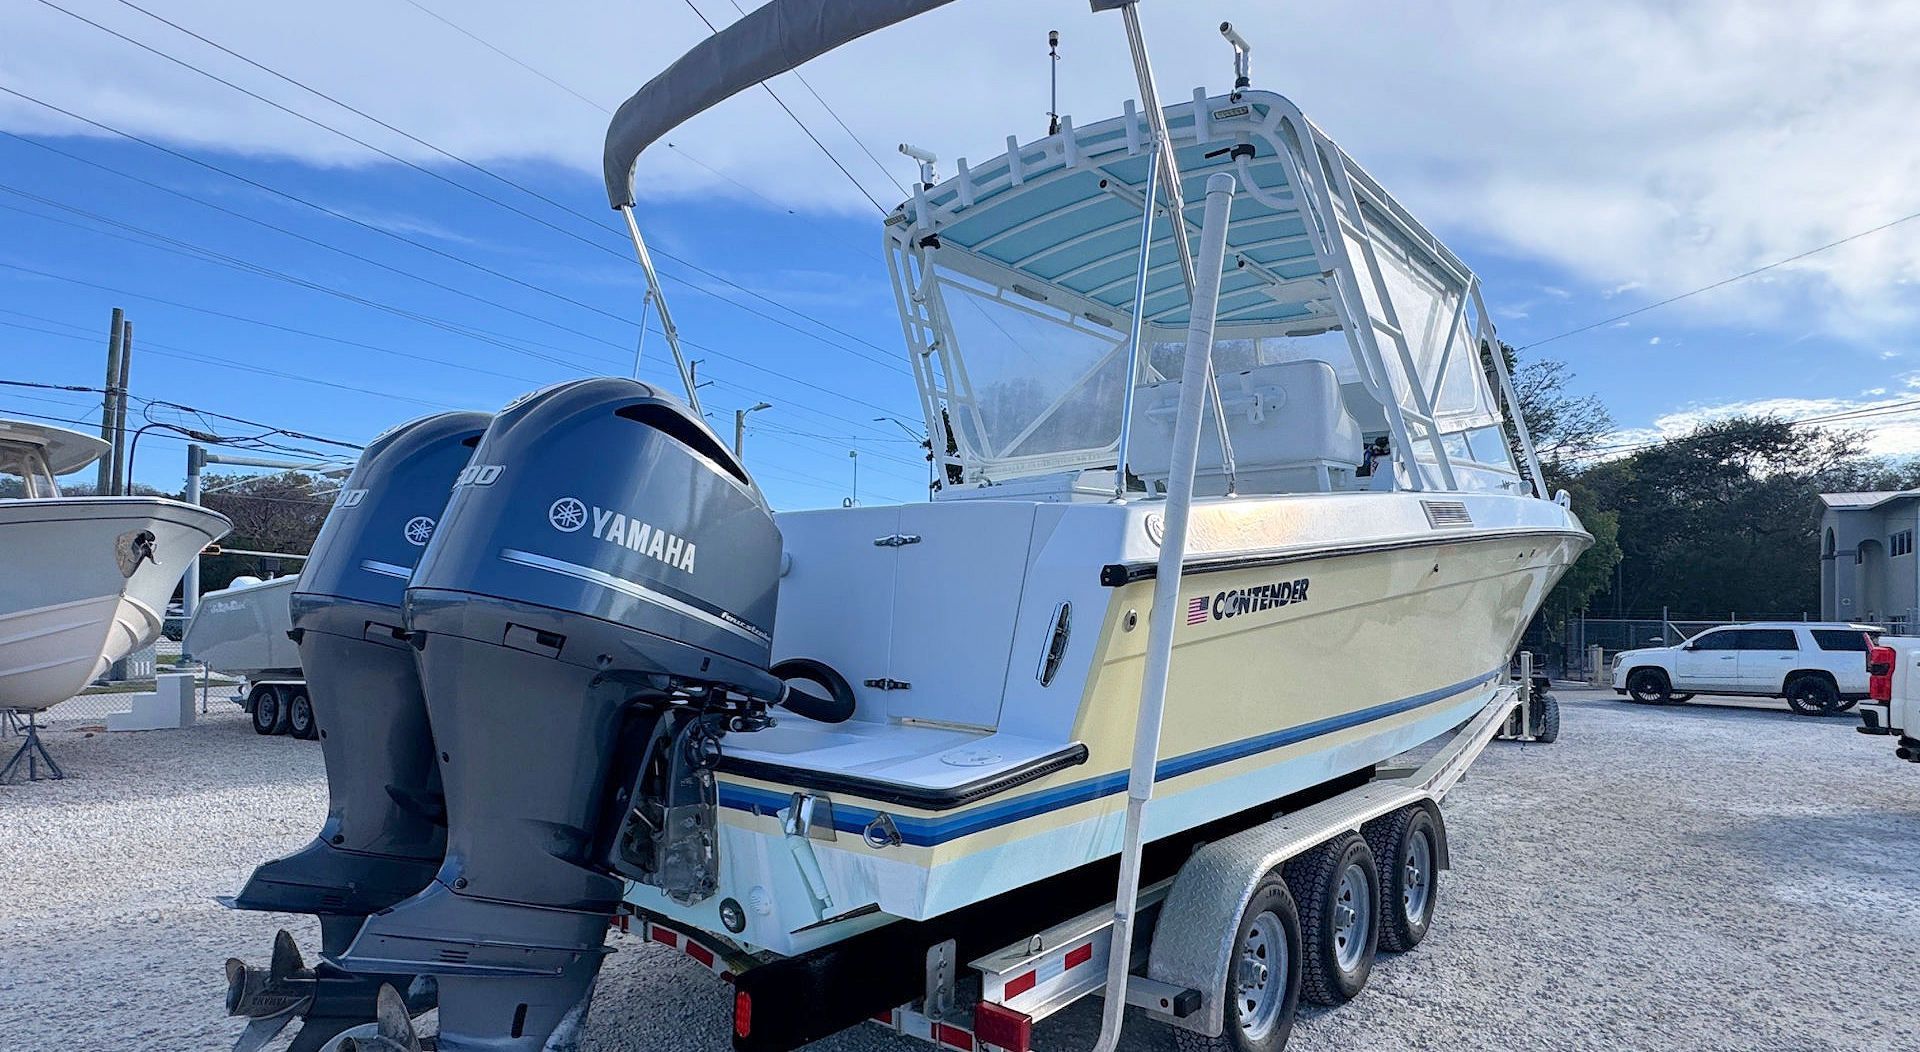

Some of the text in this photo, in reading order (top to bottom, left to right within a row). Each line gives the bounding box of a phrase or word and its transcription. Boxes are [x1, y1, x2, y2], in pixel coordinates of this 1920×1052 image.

[453, 464, 506, 487] 00
[592, 506, 696, 574] YAMAHA
[1212, 578, 1310, 621] CONTENDER
